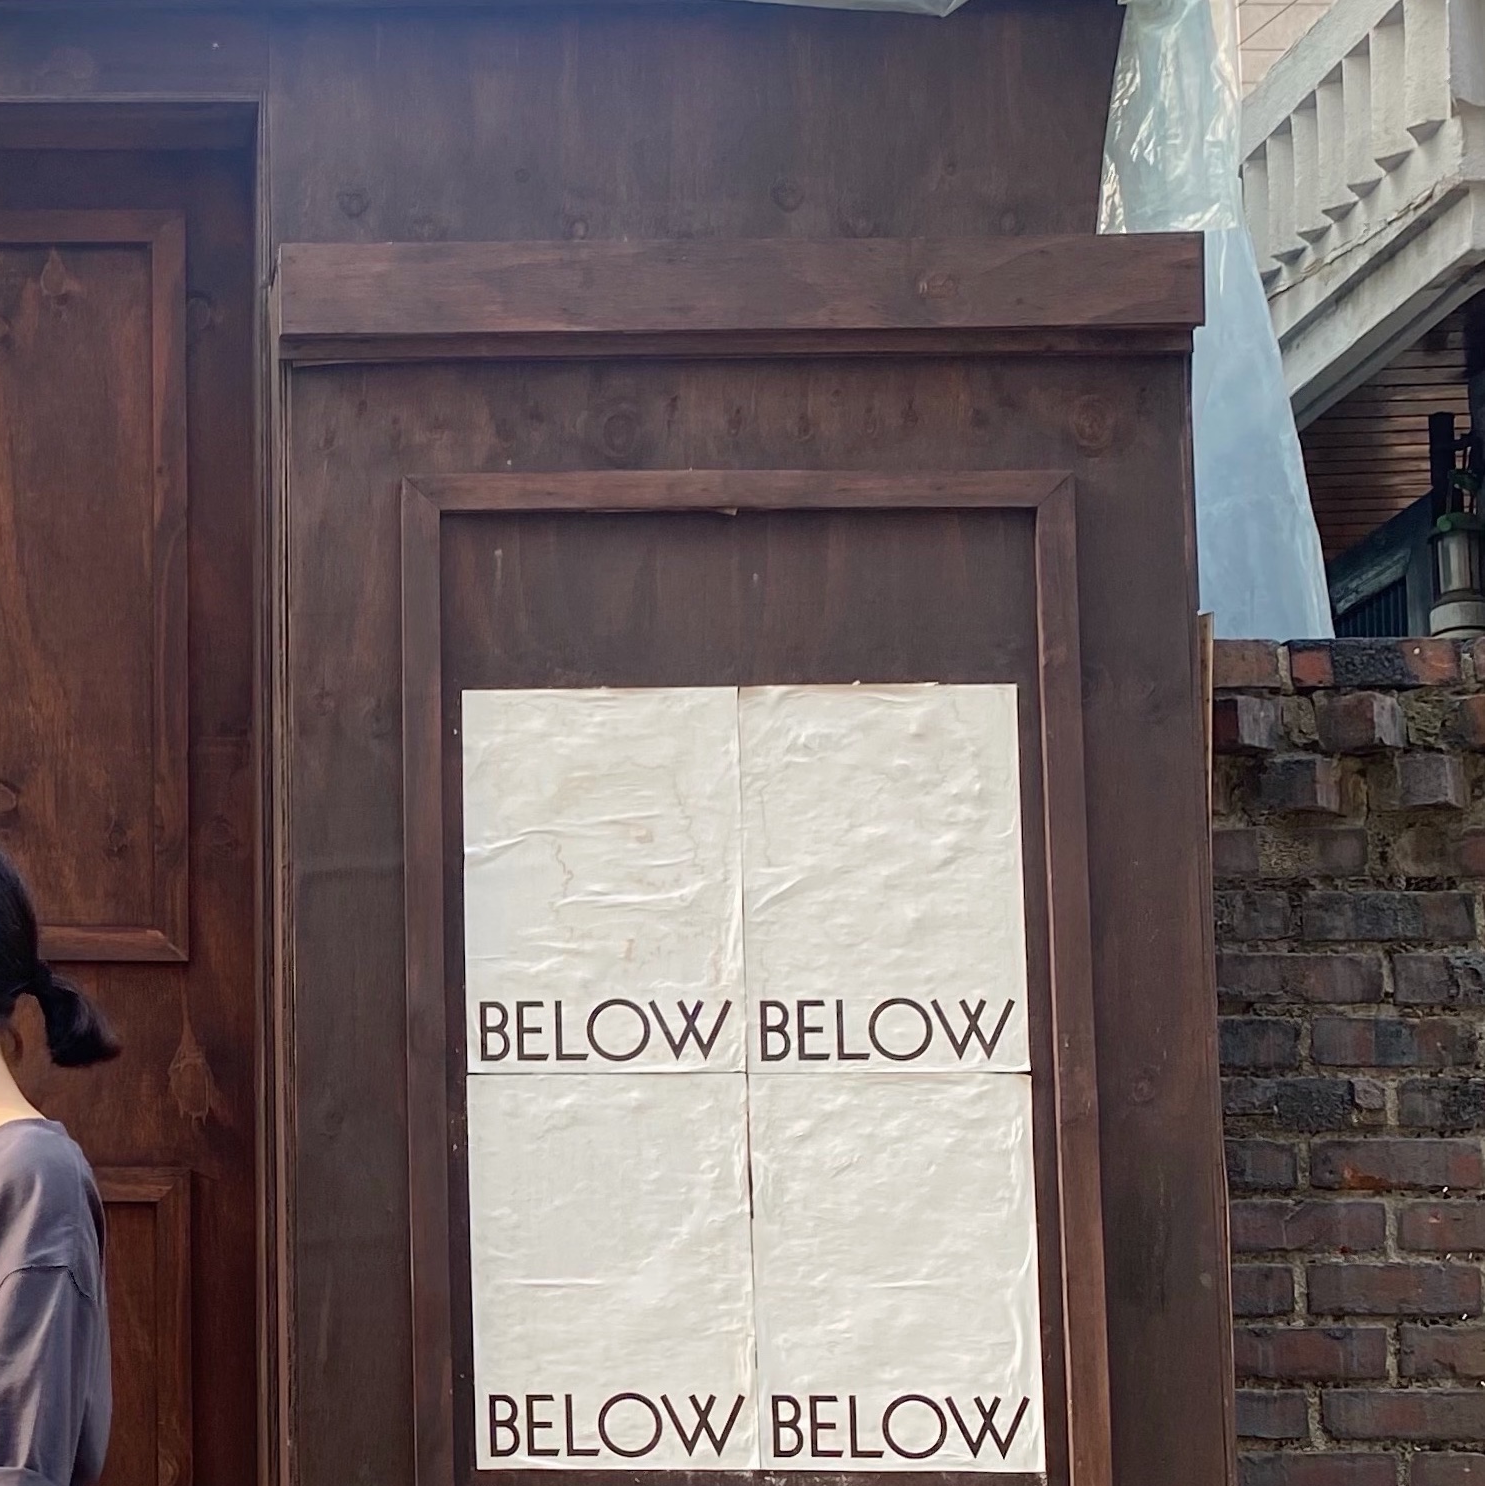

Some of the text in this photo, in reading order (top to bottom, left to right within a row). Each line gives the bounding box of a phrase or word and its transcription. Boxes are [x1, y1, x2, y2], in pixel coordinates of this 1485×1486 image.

[479, 998, 732, 1062] BELOW
[759, 997, 1016, 1062] BELOW
[488, 1392, 745, 1458] BELOW
[771, 1394, 1030, 1460] BELOW
